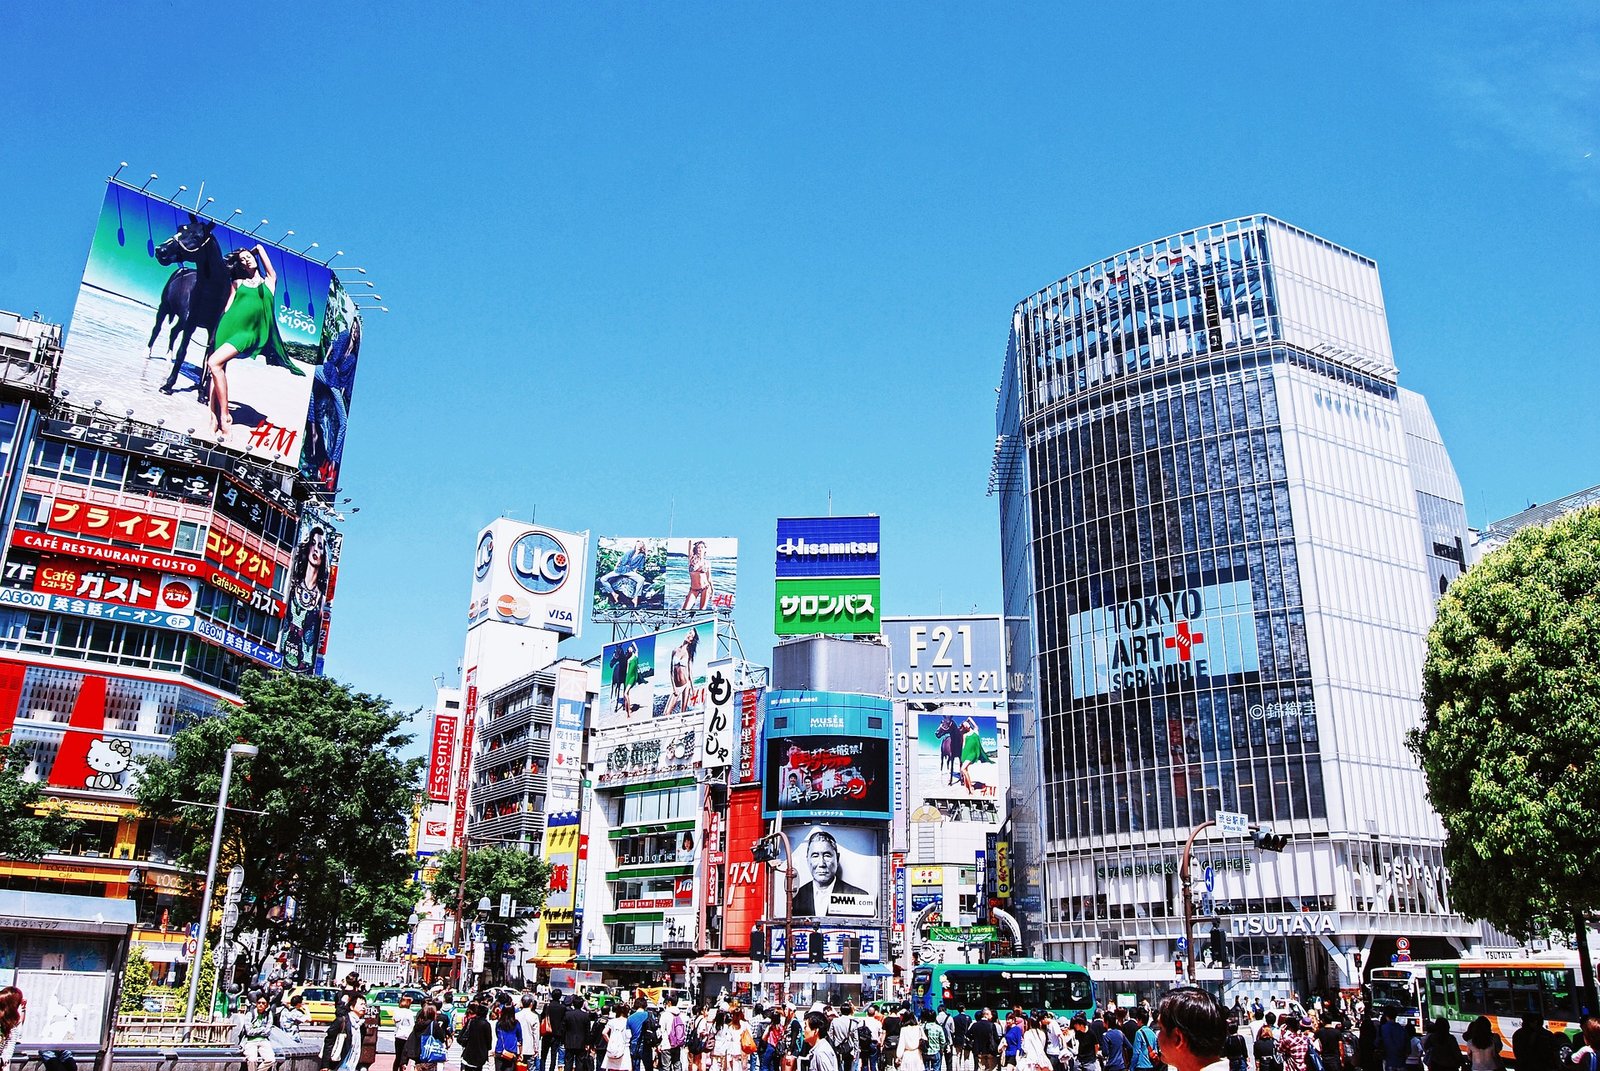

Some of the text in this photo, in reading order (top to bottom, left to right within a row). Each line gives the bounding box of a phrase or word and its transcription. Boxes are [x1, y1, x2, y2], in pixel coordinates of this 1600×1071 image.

[279, 313, 316, 334] ¥1,990
[249, 419, 297, 456] H&M
[53, 503, 171, 540] プライス
[24, 536, 197, 572] CAFÉ RESTAURANT GUSTO
[207, 531, 271, 578] コンタクト
[777, 538, 878, 555] Hisamitsu
[5, 562, 36, 580] 7F
[42, 568, 76, 582] Café
[211, 573, 229, 590] Café
[41, 580, 74, 591] レストラン
[75, 571, 152, 604] ガスト
[165, 592, 188, 602] ガスト
[249, 589, 281, 616] ガスト
[779, 594, 875, 615] サロンパス
[1, 590, 185, 628] AEON 英会話イーオン 6F
[549, 609, 573, 622] VISA
[1107, 590, 1203, 633] TOKYO
[199, 621, 224, 640] AEON
[225, 632, 282, 665] 英会話イーオン
[909, 625, 972, 668] F21
[1111, 630, 1165, 670] ART
[978, 671, 999, 694] 21
[1112, 659, 1208, 692] SCRAMBLE
[707, 670, 732, 763] もんじゃ
[430, 717, 451, 798] Essential
[561, 742, 576, 752] まで
[566, 756, 580, 766] 地下
[894, 771, 903, 811] neon
[624, 851, 676, 863] Euphoria
[1202, 858, 1251, 871] OFFEE
[677, 878, 693, 894] JTB
[727, 862, 759, 908] クスリ
[830, 895, 873, 906] DMM.com
[1234, 914, 1335, 935] TSUTAYA
[1486, 951, 1512, 959] TSUTAYA
